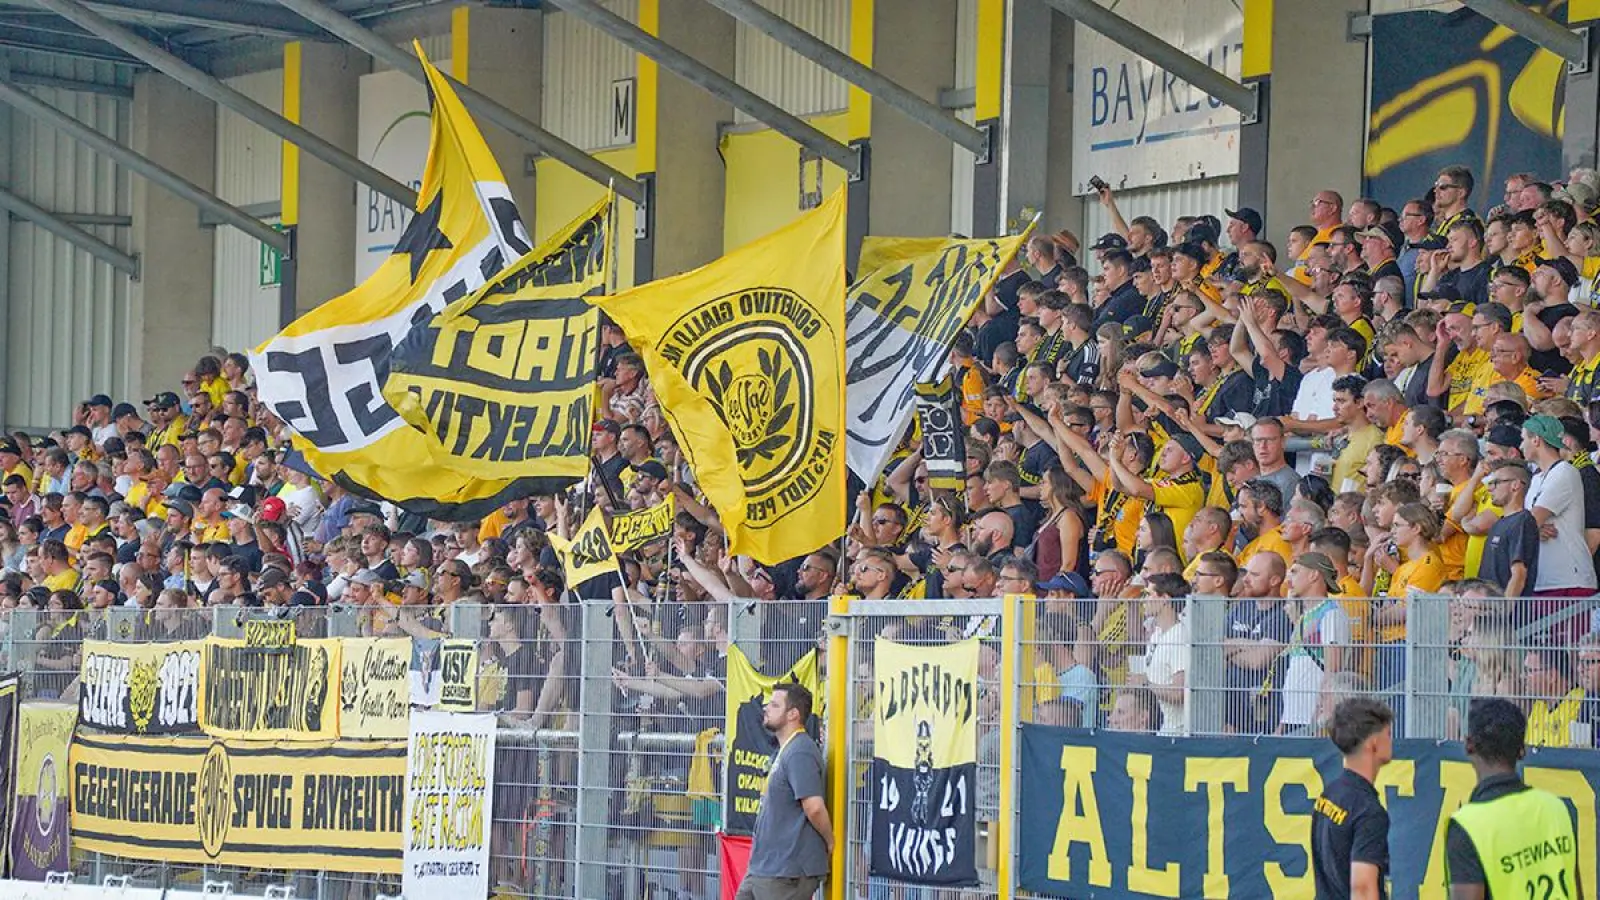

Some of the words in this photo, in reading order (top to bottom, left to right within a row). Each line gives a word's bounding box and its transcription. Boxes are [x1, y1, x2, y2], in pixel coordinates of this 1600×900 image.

[614, 86, 629, 137] M
[83, 651, 130, 727] SZENE
[158, 649, 201, 727] 1921
[411, 731, 438, 791] LOVE
[439, 731, 488, 791] FOOTBALL
[75, 761, 197, 825] GEGENGERADE
[231, 773, 294, 829] SPVGG
[302, 774, 404, 833] BAYREUTH
[411, 792, 439, 851] HATE
[1500, 835, 1572, 874] STEWARD
